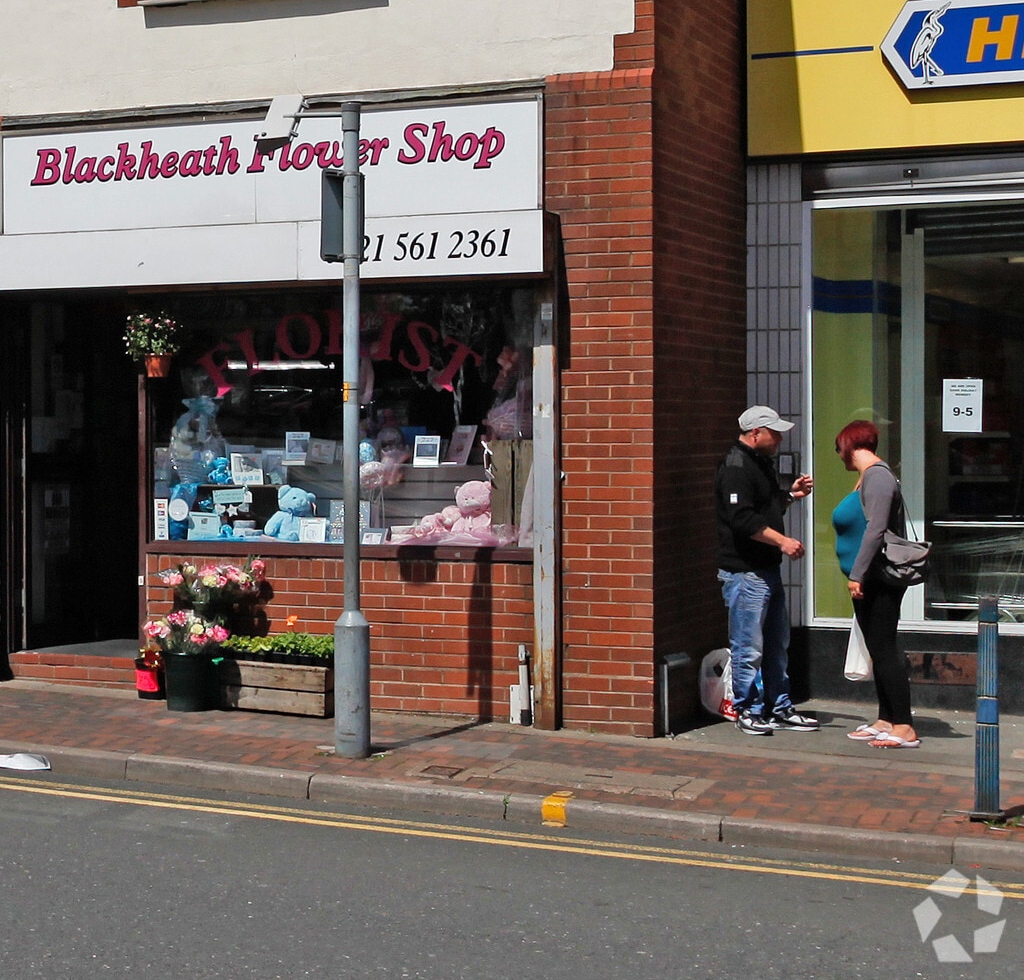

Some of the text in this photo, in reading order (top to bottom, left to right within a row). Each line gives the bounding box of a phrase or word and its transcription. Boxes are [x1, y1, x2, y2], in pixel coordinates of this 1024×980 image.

[30, 135, 241, 187] Blackheath
[397, 120, 506, 170] Shop
[393, 231, 440, 262] 561
[448, 227, 511, 259] 2361
[953, 406, 973, 416] 9-5
